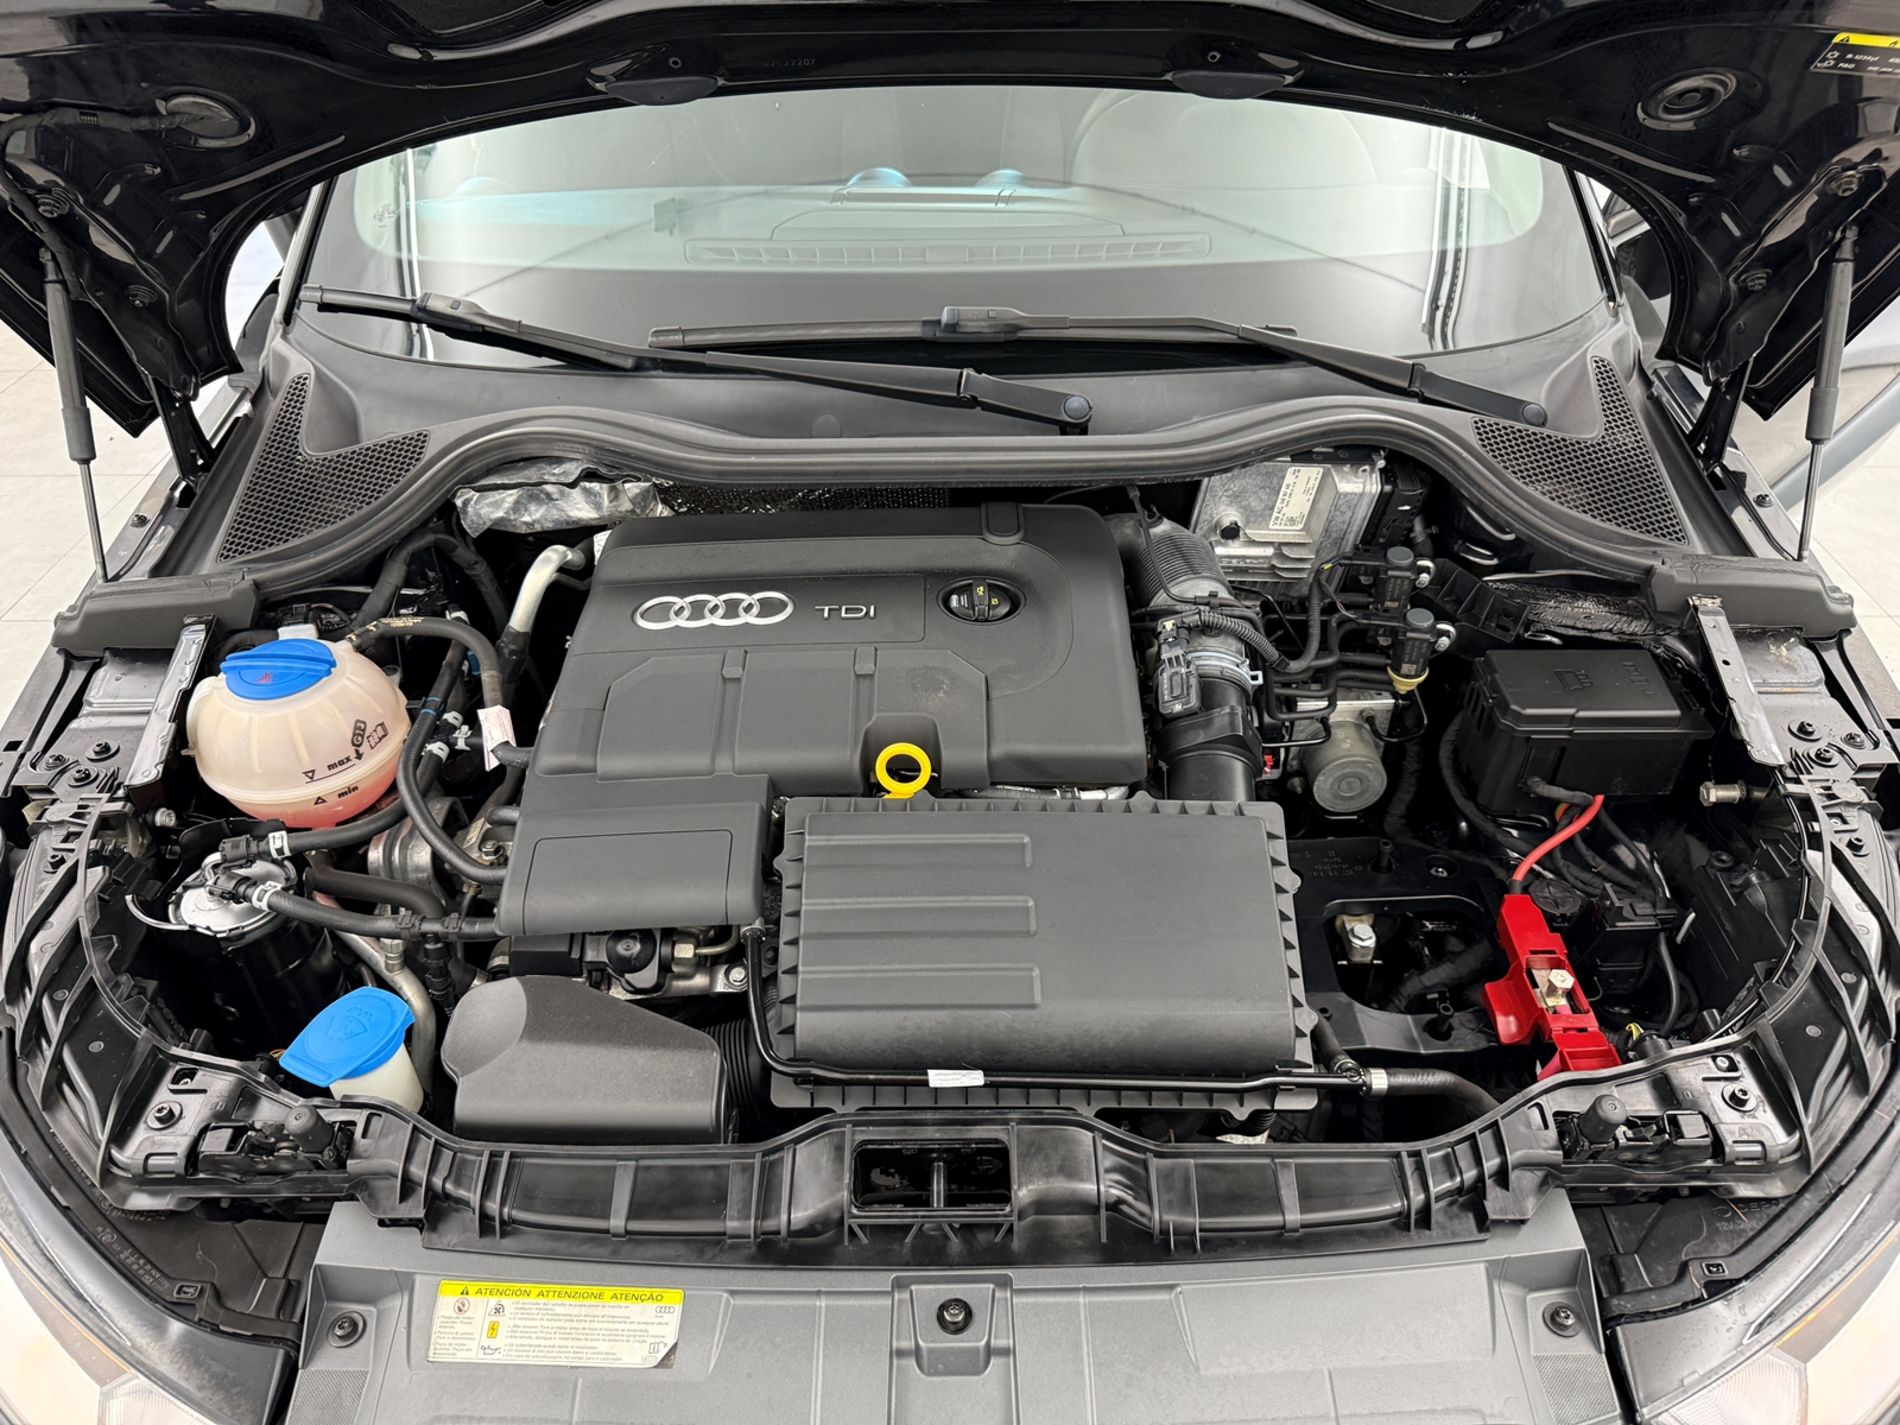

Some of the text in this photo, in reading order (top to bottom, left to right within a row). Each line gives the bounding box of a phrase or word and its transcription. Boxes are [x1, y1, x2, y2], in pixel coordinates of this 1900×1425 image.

[814, 604, 876, 620] TDI
[327, 755, 353, 771] max
[338, 785, 359, 799] min
[475, 1287, 664, 1302] ATENCIÓN ATTENZIONE ATENÇÃO
